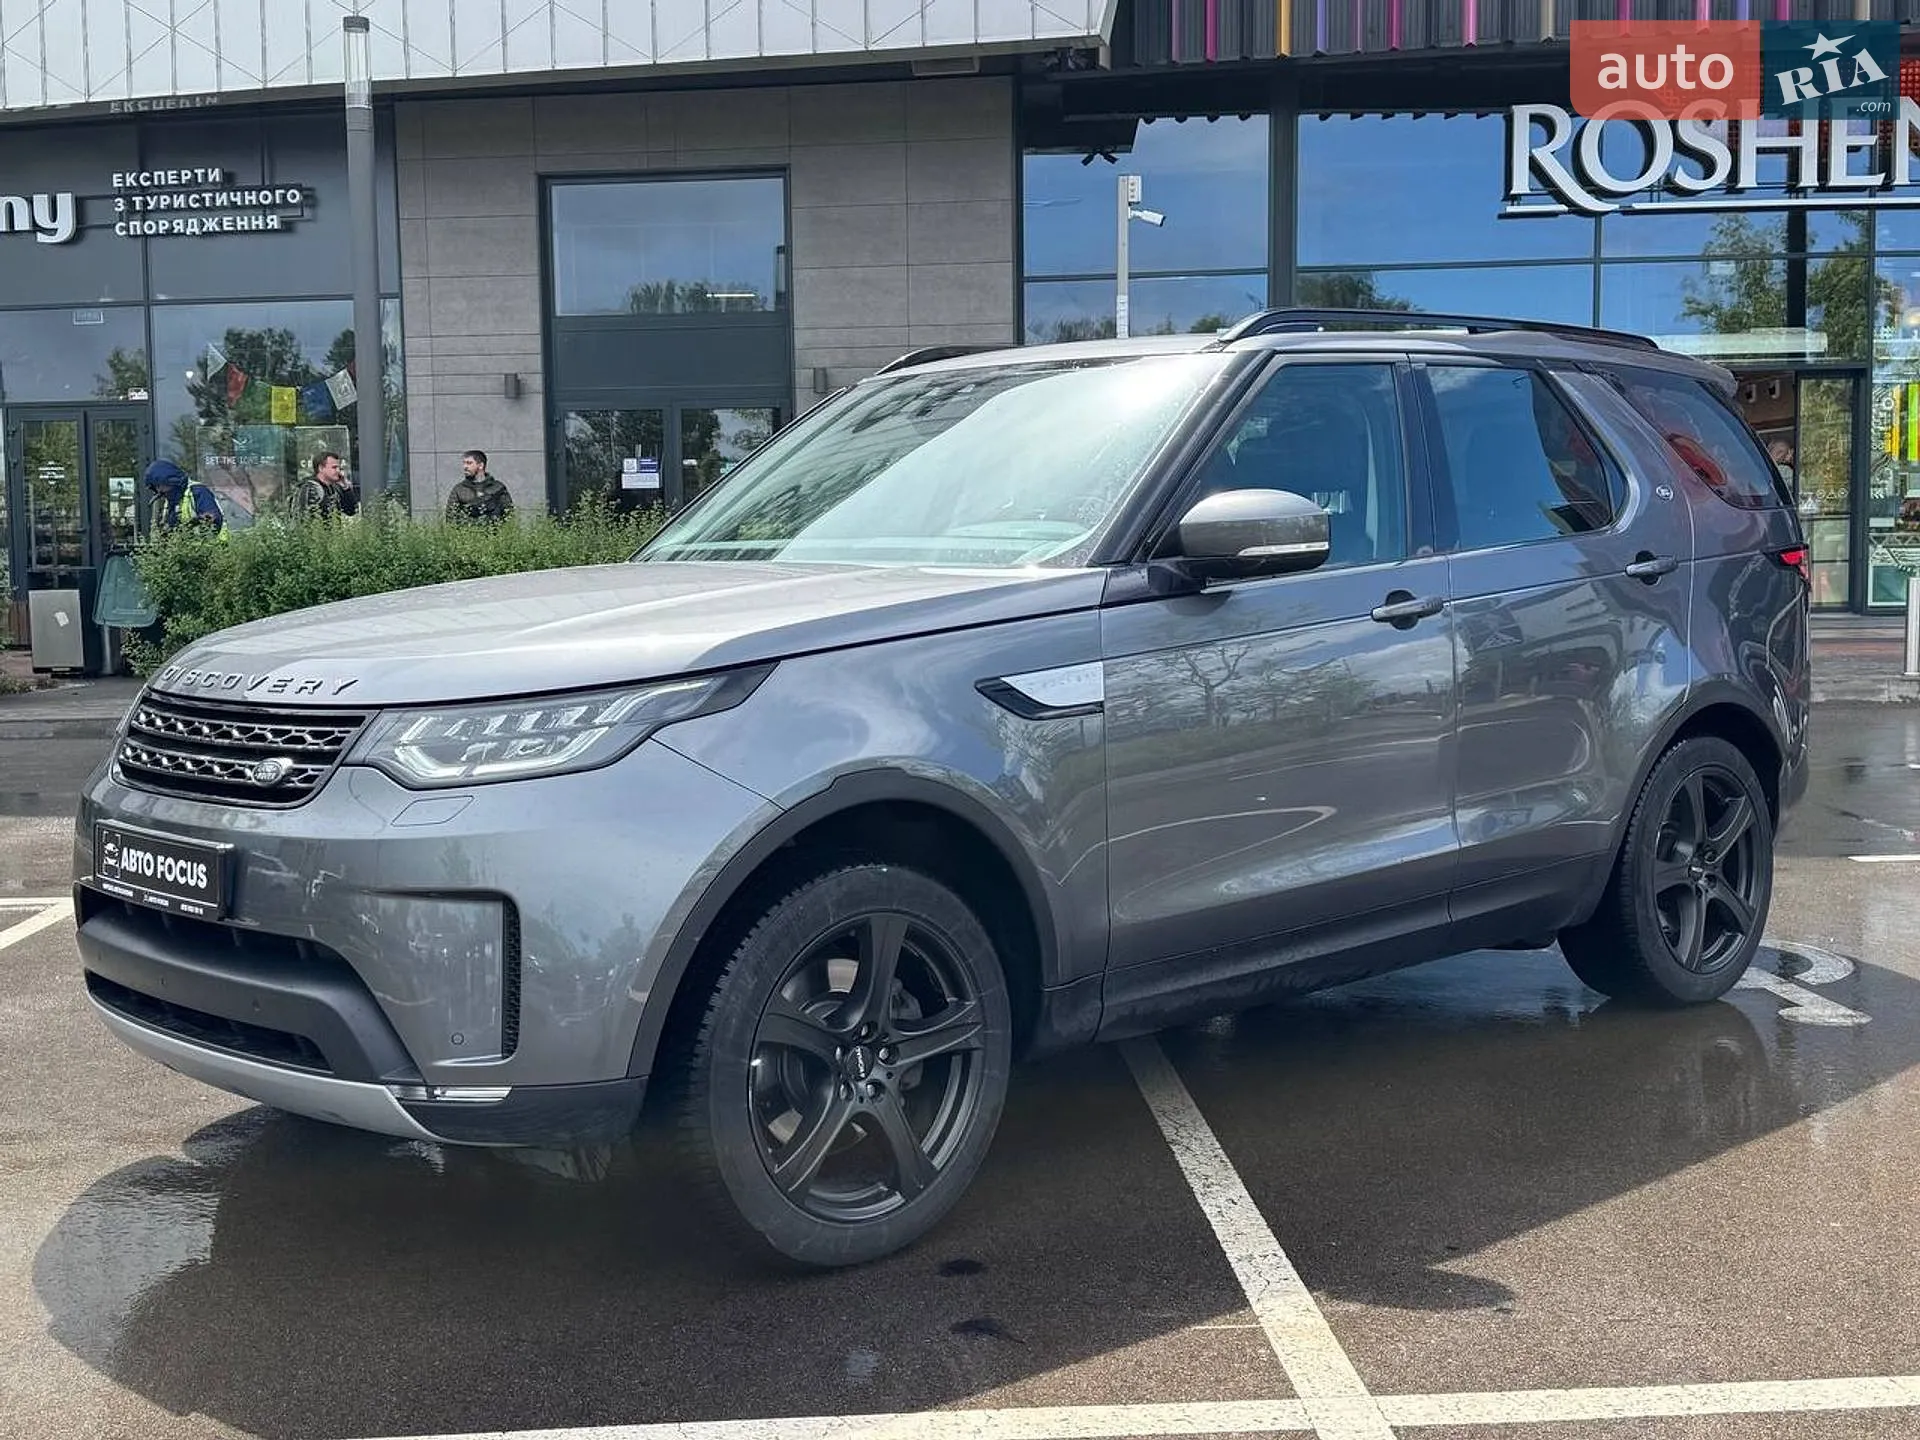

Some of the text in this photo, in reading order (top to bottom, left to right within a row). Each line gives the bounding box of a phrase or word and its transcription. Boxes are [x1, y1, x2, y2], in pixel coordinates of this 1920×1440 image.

[112, 168, 222, 187] ЕКСПЕРТИ
[132, 189, 300, 211] ТУРИСТИЧНОГО
[115, 215, 281, 236] СПОРЯДЖЕННЯ
[161, 665, 359, 696] DISCOVERY
[157, 854, 208, 889] FOCUS
